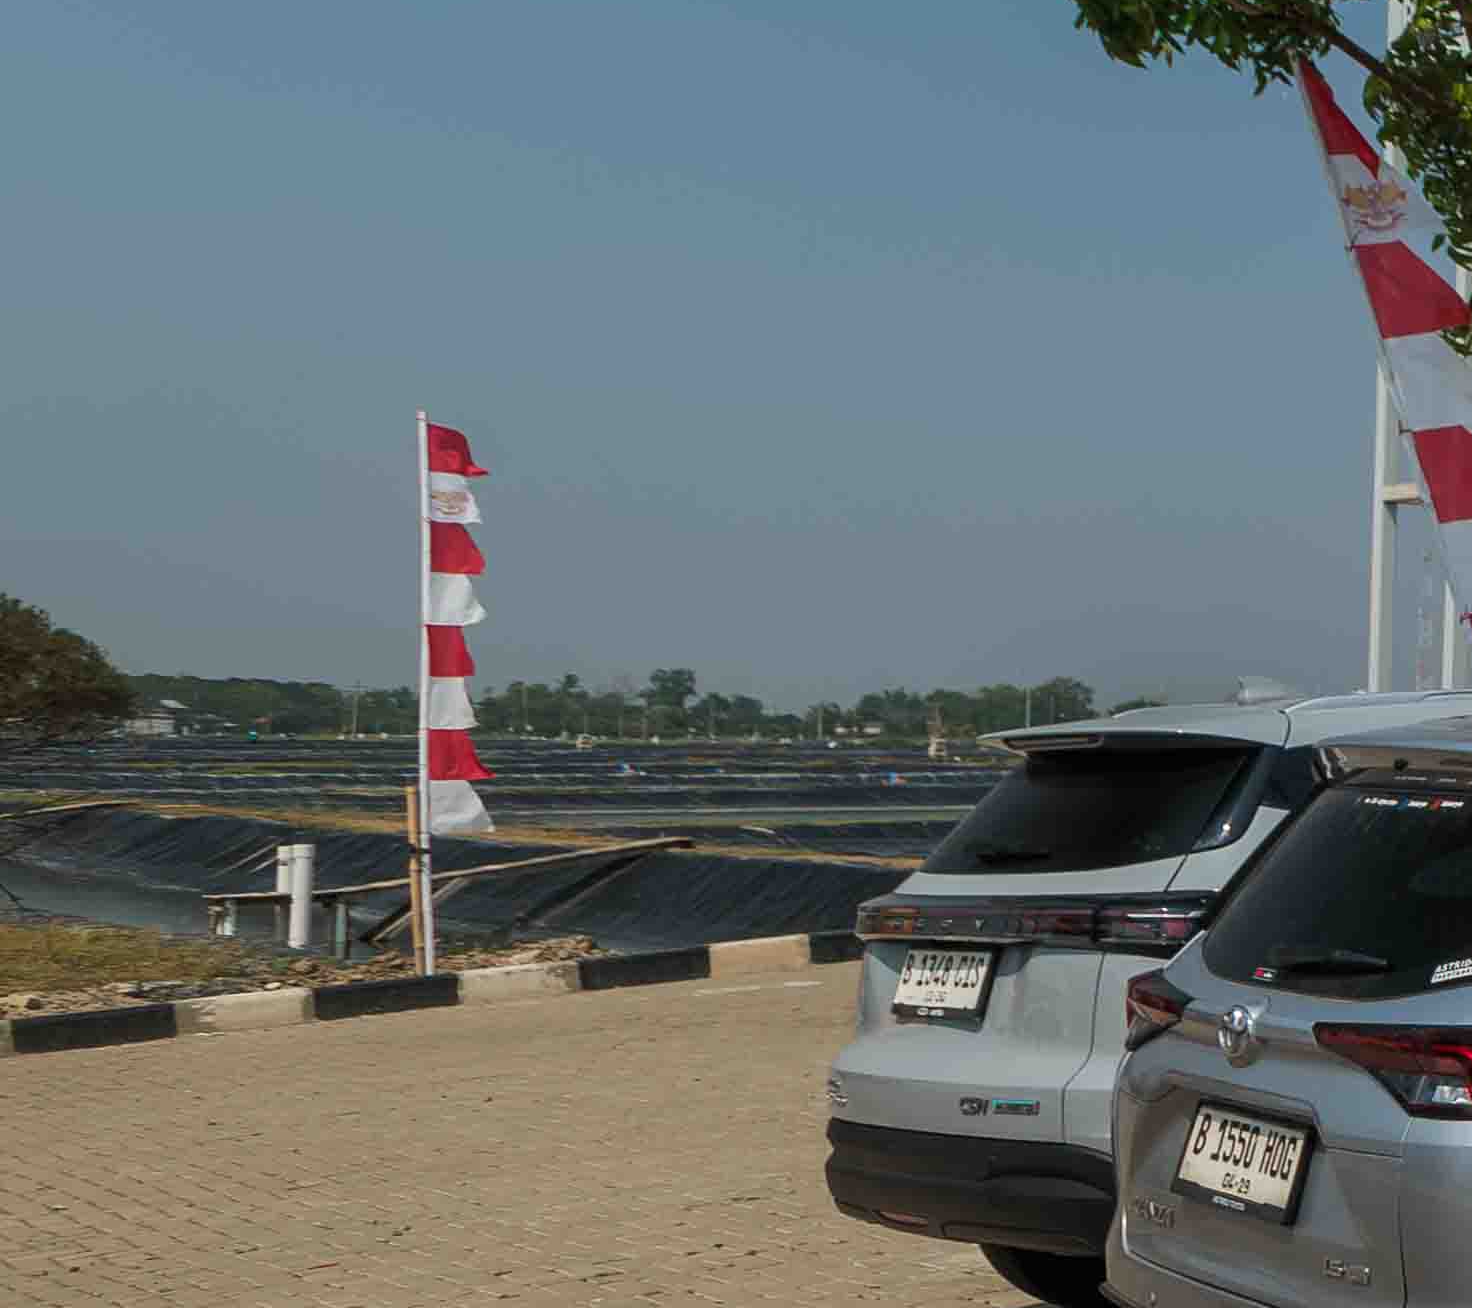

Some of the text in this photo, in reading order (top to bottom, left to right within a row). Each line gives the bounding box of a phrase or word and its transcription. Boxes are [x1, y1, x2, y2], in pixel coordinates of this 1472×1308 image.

[902, 953, 914, 985] B
[1192, 1114, 1297, 1180] B 1550 HOG
